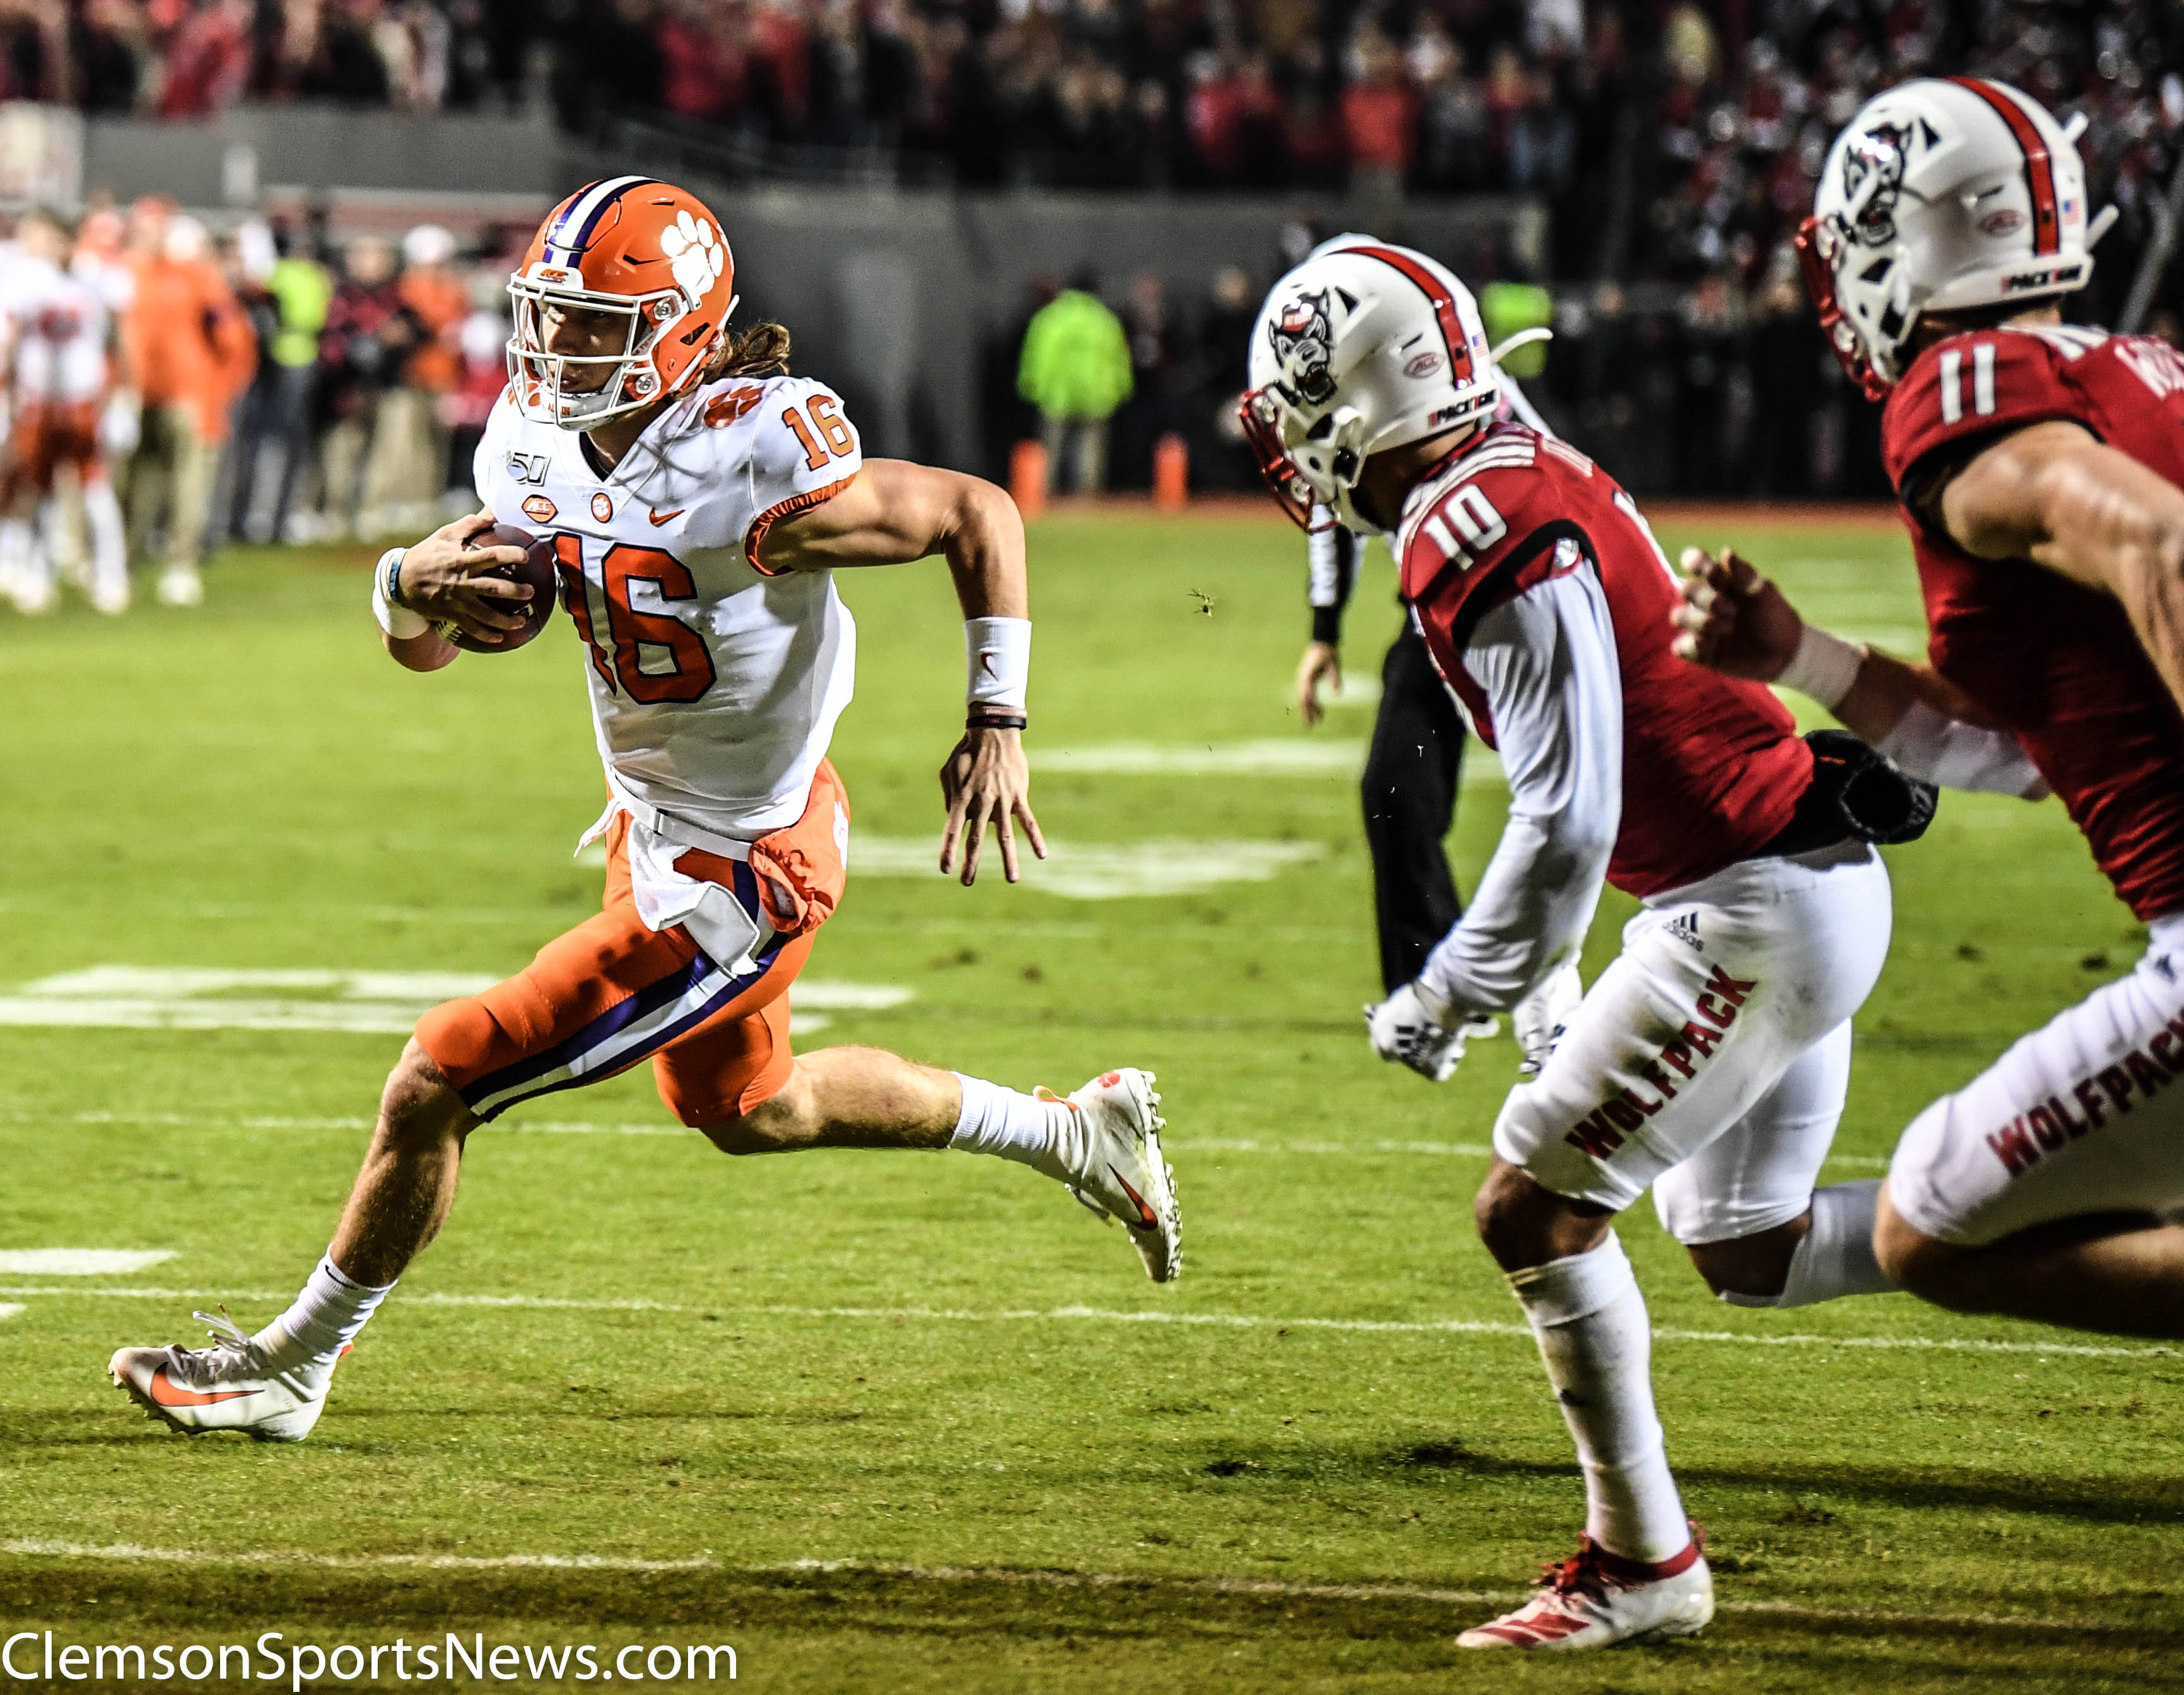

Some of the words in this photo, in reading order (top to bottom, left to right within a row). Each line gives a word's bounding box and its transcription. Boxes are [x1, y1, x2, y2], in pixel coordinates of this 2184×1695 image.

[1940, 343, 1997, 425] 11
[781, 394, 855, 472] 16
[524, 501, 551, 512] ACC
[1423, 483, 1507, 572] 10
[551, 531, 718, 705] 16
[1662, 919, 1705, 953] adidas
[1564, 963, 1758, 1161] WOLFPACK
